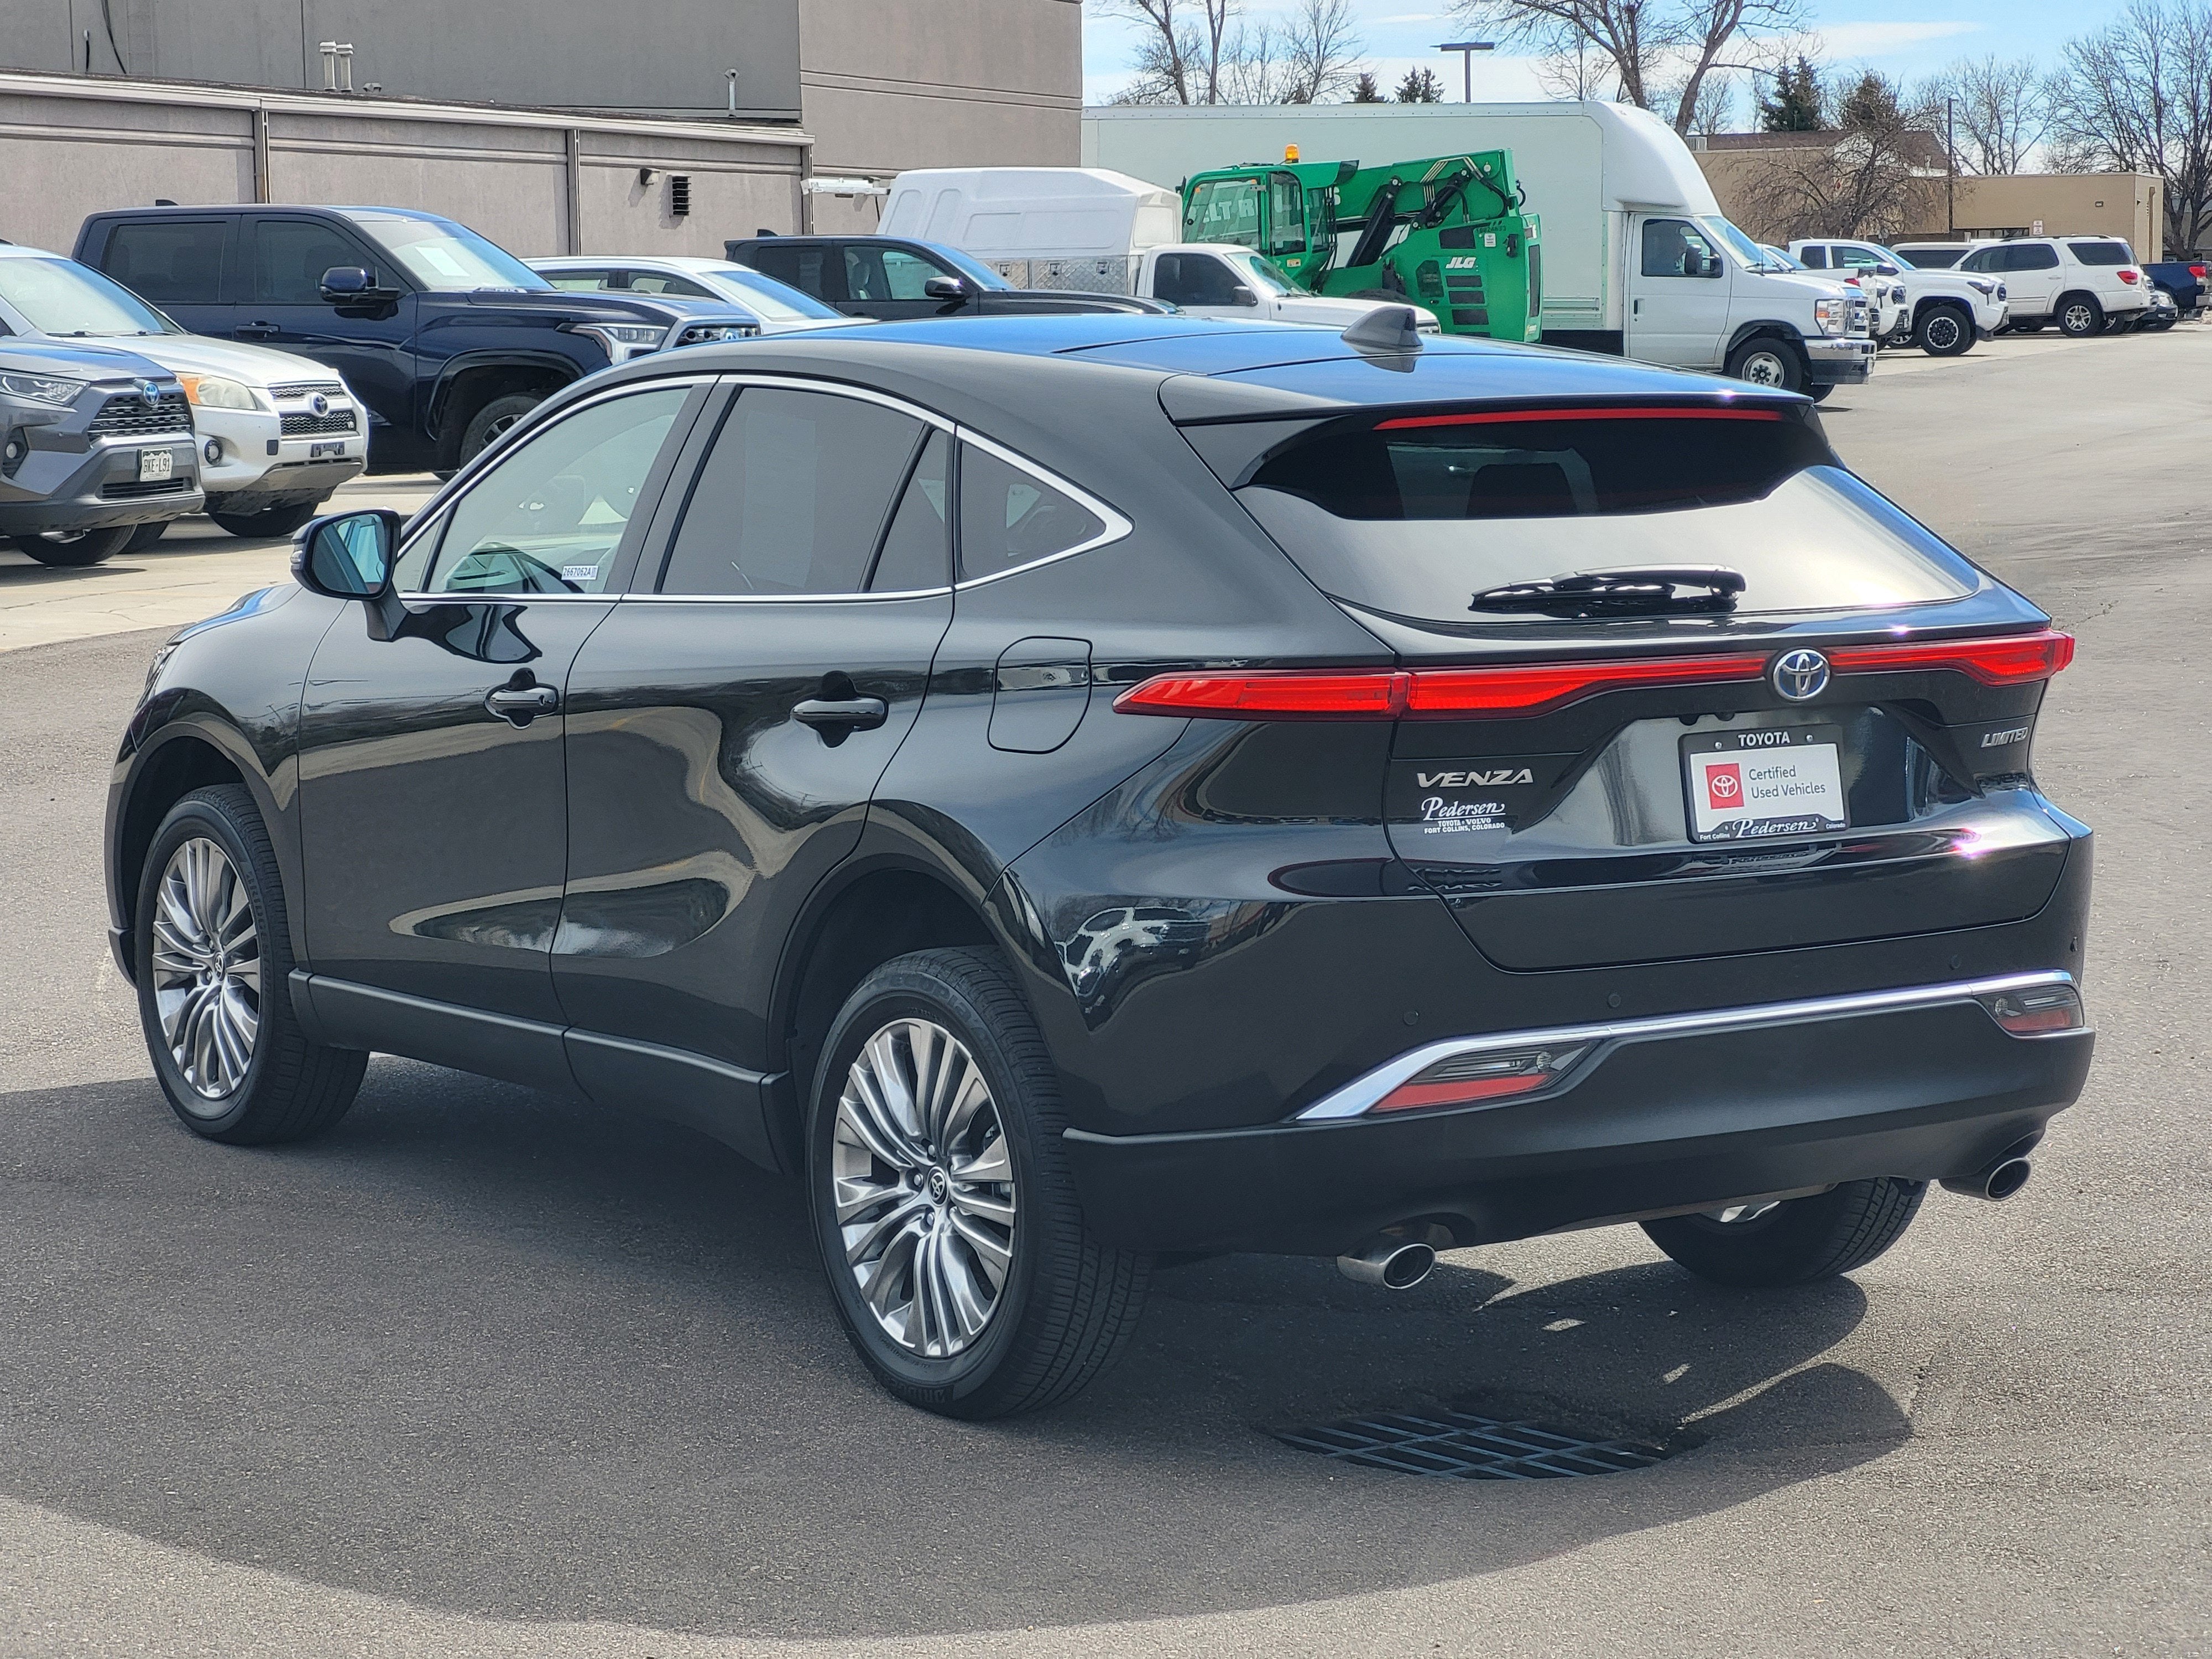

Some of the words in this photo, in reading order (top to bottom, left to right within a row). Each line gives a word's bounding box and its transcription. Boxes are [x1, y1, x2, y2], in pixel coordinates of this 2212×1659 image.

[1445, 257, 1477, 269] JLG
[1738, 731, 1791, 747] TOYOTA
[1980, 727, 2028, 748] LIMITED
[1417, 768, 1533, 787] VENZA
[1749, 765, 1796, 781] Certified
[1751, 785, 1779, 799] Used
[1781, 782, 1826, 796] Vehicles
[1421, 796, 1505, 821] Pedersen
[1472, 822, 1505, 831] COLORADO
[1732, 818, 1817, 838] Pedersen
